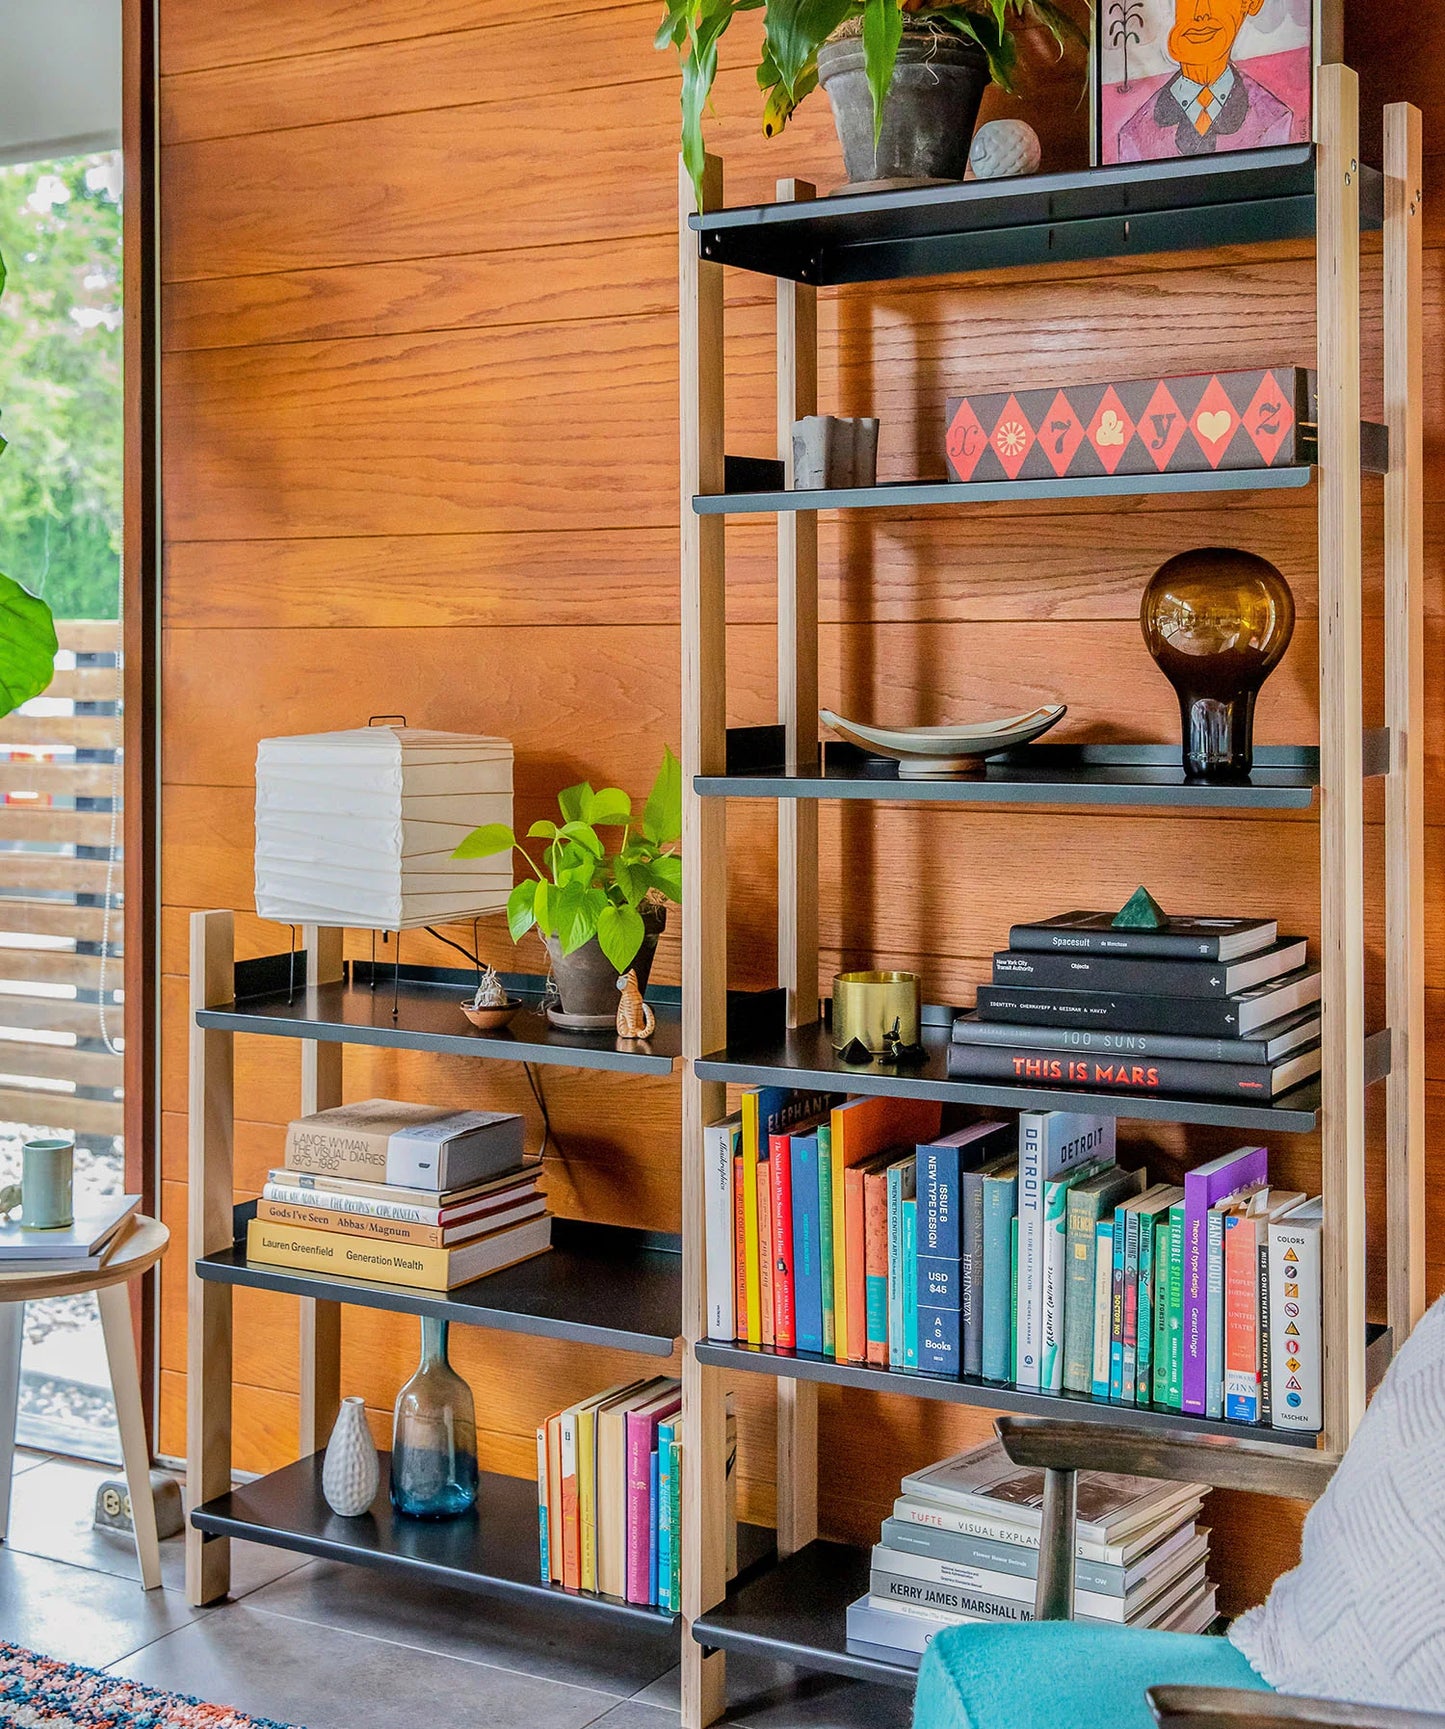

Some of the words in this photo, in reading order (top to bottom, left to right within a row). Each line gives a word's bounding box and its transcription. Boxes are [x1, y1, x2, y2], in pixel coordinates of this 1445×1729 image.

[1051, 419, 1072, 454] 7
[1052, 936, 1090, 947] Spacesuit
[1012, 965, 1034, 973] Authority
[1062, 1031, 1092, 1046] 100
[1103, 1034, 1147, 1050] SUNS
[1012, 1056, 1062, 1080] THIS
[1068, 1060, 1089, 1081] IS
[1095, 1063, 1159, 1088] MARS
[768, 1094, 832, 1132] ELEPHANT
[293, 1133, 326, 1147] LANCE
[329, 1138, 370, 1152] WYMAN:
[1060, 1127, 1104, 1163] DETROIT
[293, 1144, 311, 1155] THE
[314, 1147, 346, 1161] VISUAL
[349, 1151, 386, 1166] DIARIES
[774, 1152, 782, 1171] Naked
[774, 1171, 783, 1186] Lady
[928, 1155, 937, 1180] NEW
[1024, 1127, 1038, 1211] DETROIT
[776, 1186, 784, 1201] Who
[928, 1181, 937, 1208] TYPE
[939, 1183, 948, 1214] ISSUE
[974, 1187, 982, 1207] THE
[269, 1207, 291, 1219] Gods
[308, 1213, 329, 1225] Seen
[337, 1217, 365, 1231] Abbas
[368, 1222, 410, 1239] Magnum
[928, 1209, 937, 1248] DESIGN
[940, 1215, 948, 1223] 8
[974, 1209, 982, 1229] SUN
[1128, 1218, 1137, 1231] IAN
[1142, 1217, 1151, 1230] IAN
[1209, 1216, 1222, 1245] HAND
[974, 1231, 982, 1257] ALSO
[1142, 1230, 1151, 1253] FLEMING
[1171, 1224, 1181, 1263] TERRIBLE
[1192, 1219, 1200, 1246] Theory
[1277, 1235, 1305, 1245] COLORS
[262, 1237, 291, 1251] Lauren
[291, 1241, 334, 1257] Greenfield
[346, 1250, 393, 1268] Generation
[393, 1256, 424, 1271] Wealth
[1127, 1231, 1137, 1259] FLEMING
[1192, 1245, 1199, 1255] of
[974, 1259, 983, 1286] RISES
[1190, 1255, 1199, 1273] type
[1209, 1254, 1222, 1293] MOUTH
[928, 1272, 948, 1282] USD
[929, 1283, 947, 1294] $45
[1171, 1265, 1180, 1308] SPLENDOR
[1190, 1273, 1200, 1299] design
[963, 1253, 972, 1325] HEMINGWAY
[1159, 1294, 1165, 1302] M.
[934, 1317, 942, 1326] A
[1191, 1308, 1199, 1333] Gerard
[1228, 1311, 1255, 1321] UNITED
[934, 1328, 942, 1338] S
[1045, 1309, 1056, 1347] CREATIVE
[1114, 1323, 1121, 1335] NO
[925, 1339, 952, 1351] Books
[1189, 1334, 1198, 1358] Unger
[1228, 1382, 1255, 1394] ZINN
[1281, 1413, 1309, 1422] TASCHEN
[911, 1511, 943, 1526] TUFTE
[958, 1522, 995, 1537] VISUAL
[890, 1583, 923, 1599] KERRY
[925, 1590, 958, 1607] JAMES
[961, 1597, 1017, 1620] MARSHALL
